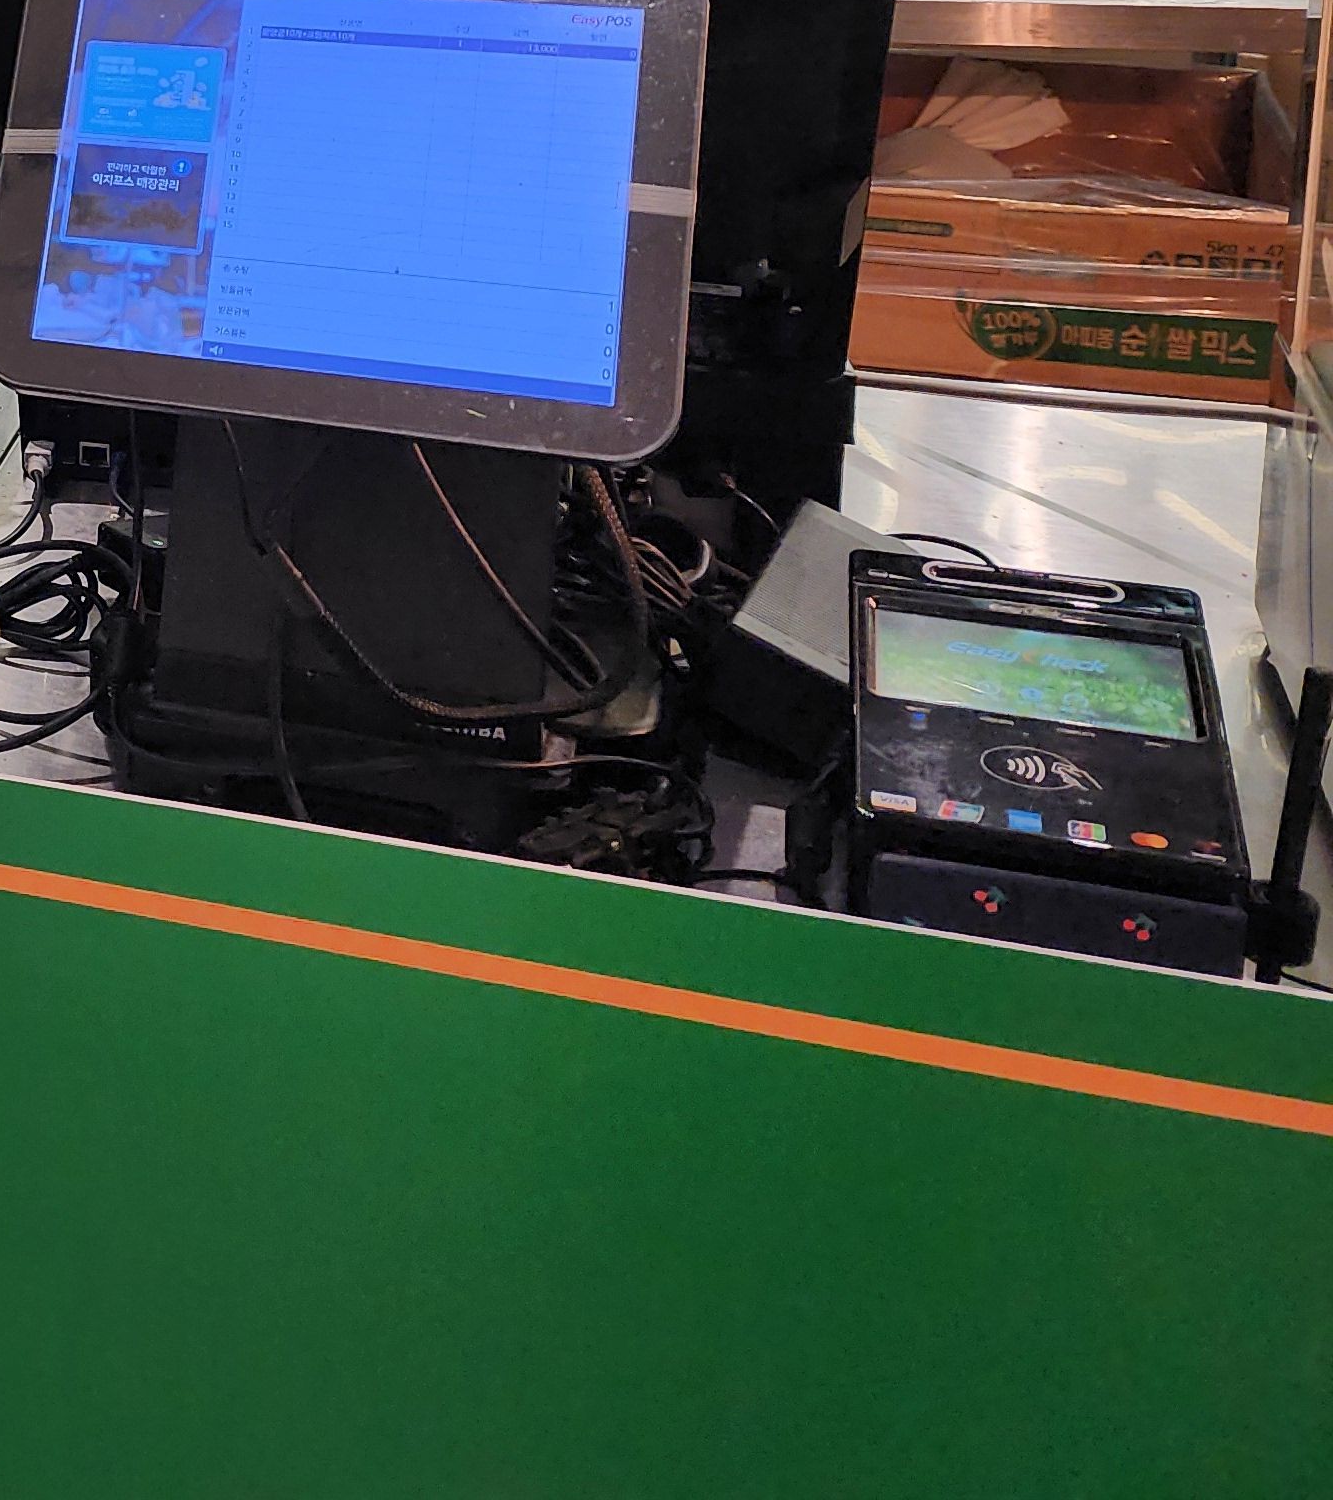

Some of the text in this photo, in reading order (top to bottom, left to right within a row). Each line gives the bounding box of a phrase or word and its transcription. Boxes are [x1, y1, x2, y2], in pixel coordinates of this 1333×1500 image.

[137, 177, 180, 191] 매장관리
[606, 324, 613, 334] 0
[604, 346, 612, 357] 0
[602, 369, 610, 380] 0
